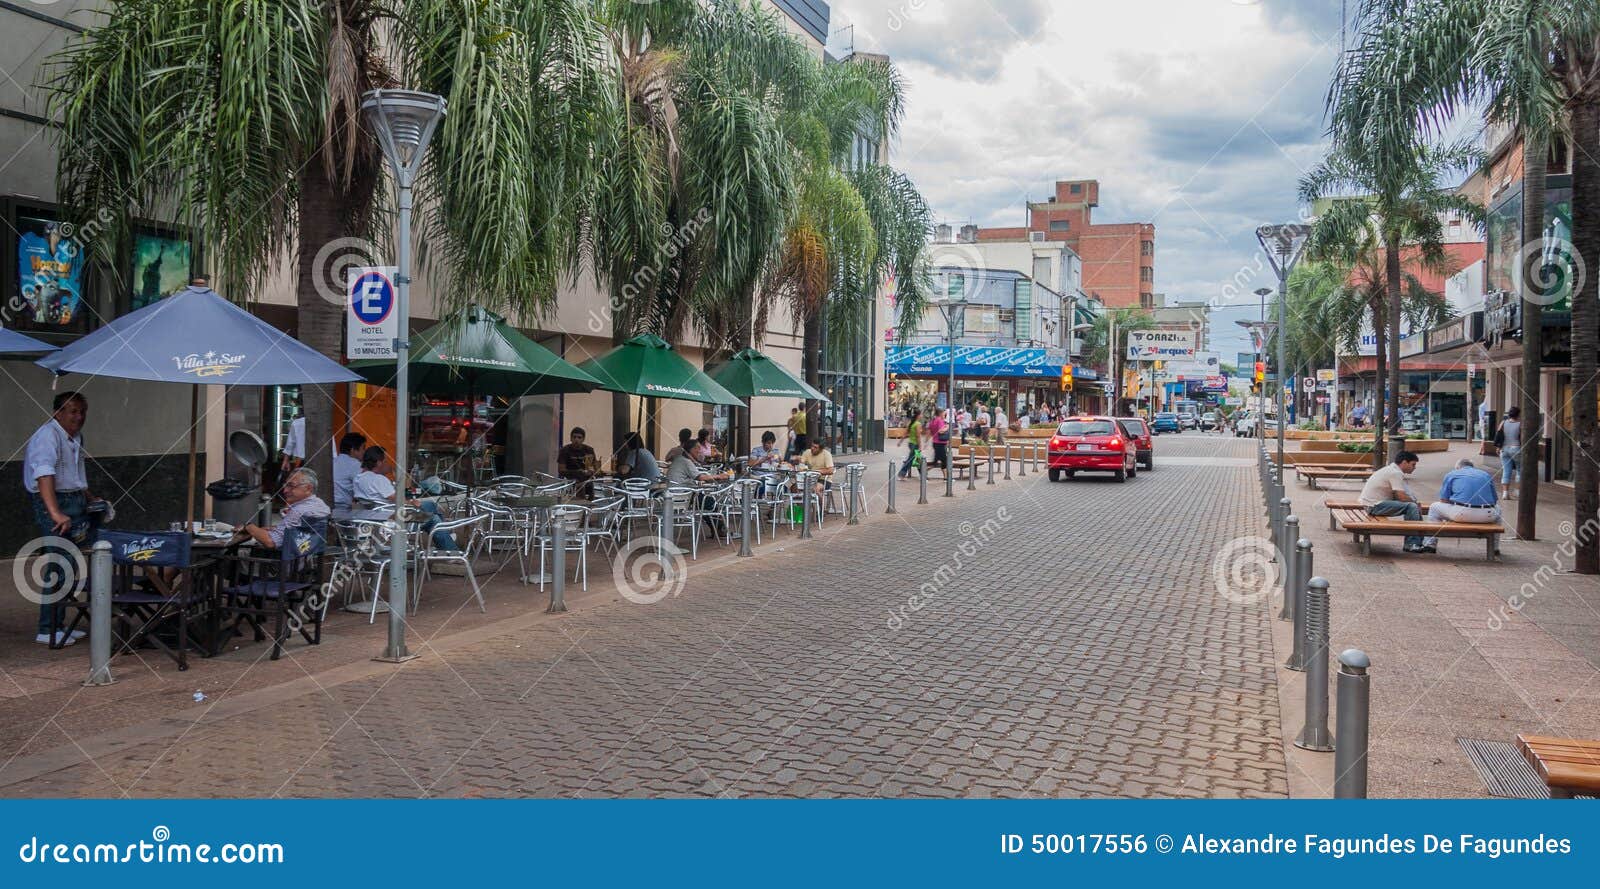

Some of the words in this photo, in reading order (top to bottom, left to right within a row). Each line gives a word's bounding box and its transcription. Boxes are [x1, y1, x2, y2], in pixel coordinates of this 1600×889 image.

[361, 280, 384, 314] E
[361, 327, 384, 335] HOTEL
[354, 347, 361, 355] 10
[362, 347, 391, 355] MINUTOS
[1147, 346, 1194, 357] Marquez
[172, 354, 204, 370] Villa
[220, 353, 246, 365] Sur
[654, 384, 701, 396] Heineken
